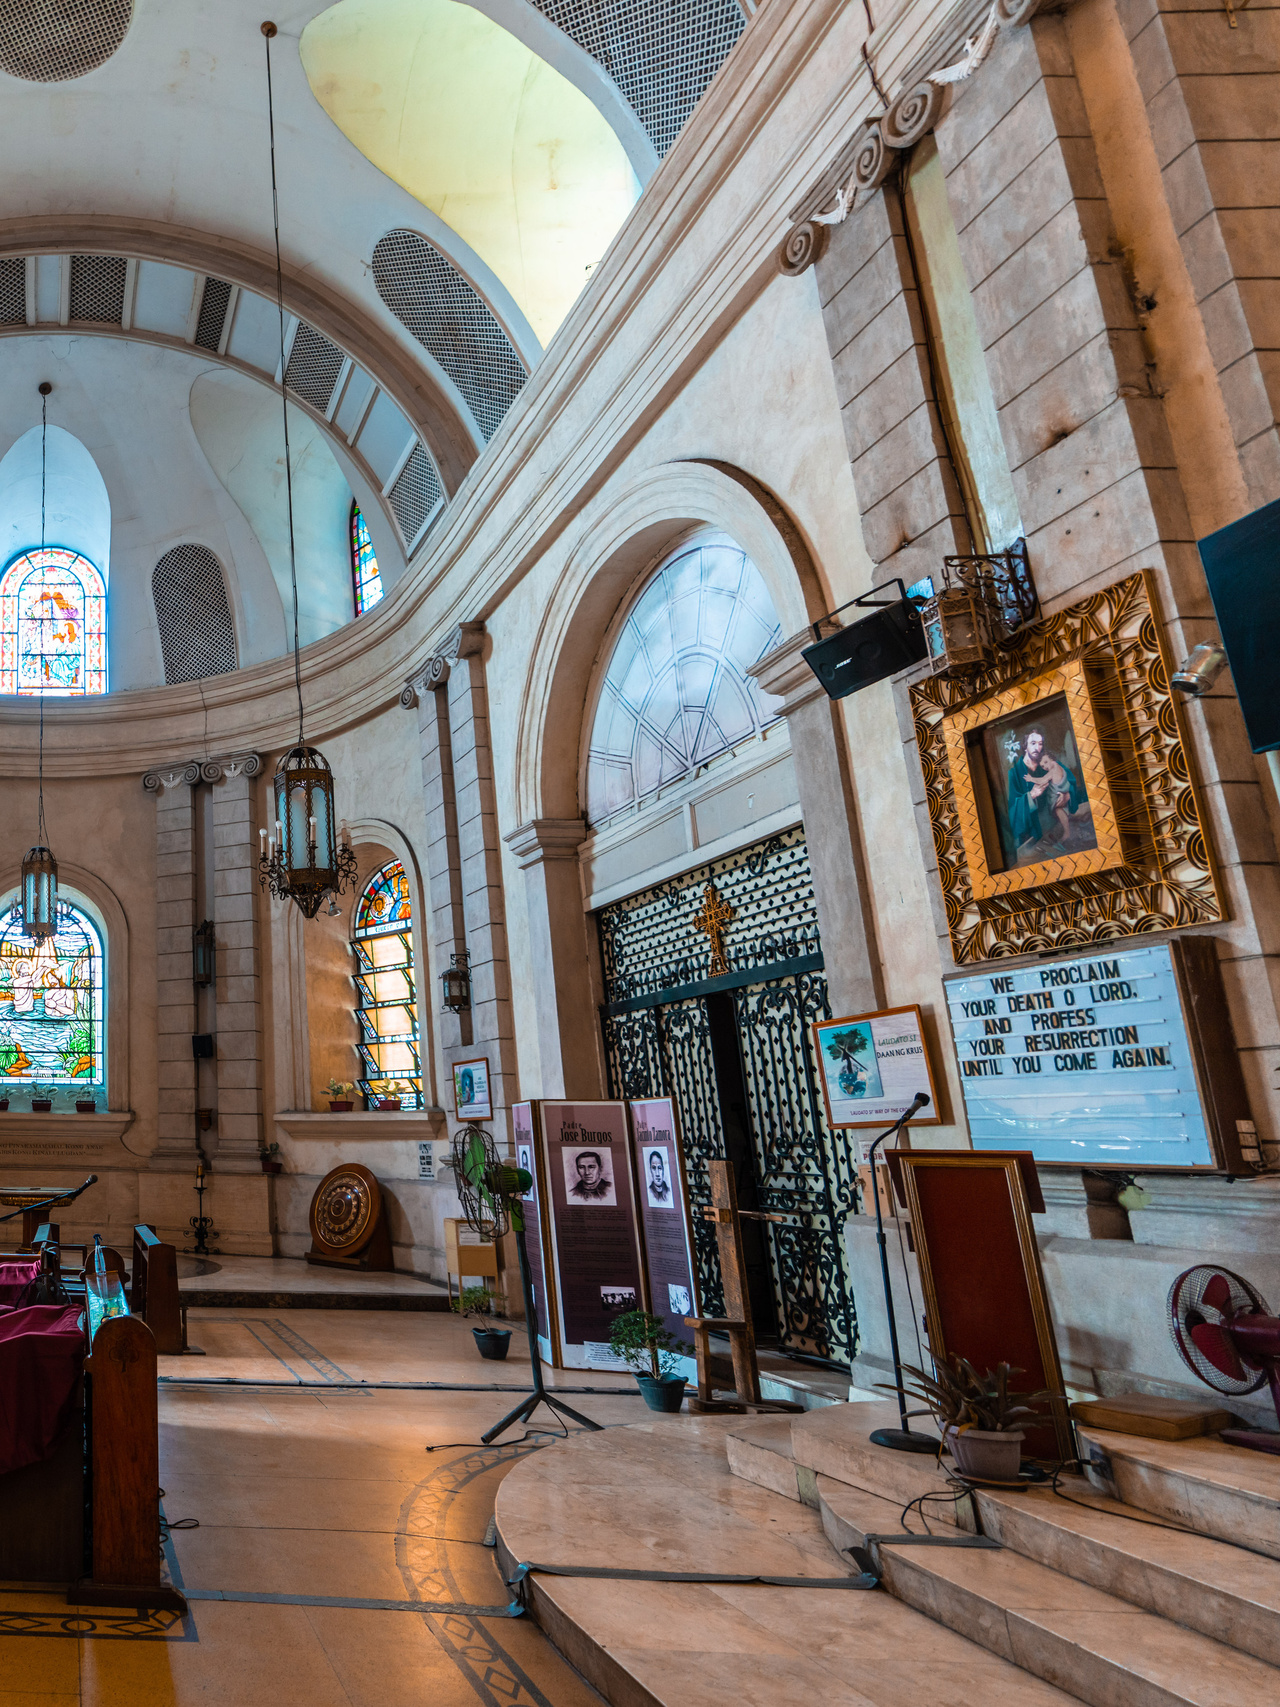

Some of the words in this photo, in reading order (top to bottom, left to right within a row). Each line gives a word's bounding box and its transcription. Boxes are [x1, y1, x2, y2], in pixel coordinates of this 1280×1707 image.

[990, 976, 1015, 994] WE
[1039, 959, 1121, 988] PROCLAIM
[961, 999, 997, 1018] YOUR
[1007, 991, 1055, 1013] DEATH
[1064, 989, 1075, 1006] O
[1089, 981, 1138, 1003] LORD,
[984, 1017, 1012, 1035] AND
[1031, 1008, 1096, 1031] PROFESS
[877, 1050, 895, 1059] DAAN
[895, 1048, 905, 1056] NG
[906, 1046, 923, 1055] KRUS
[878, 1035, 908, 1046] LAUDATO
[969, 1038, 1006, 1056] YOUR
[1024, 1025, 1139, 1053] RESURRECTION
[962, 1059, 1003, 1077] UNTIL
[1012, 1056, 1041, 1074] YOU
[1054, 1052, 1097, 1071] COME
[1112, 1047, 1171, 1069] AGAIN.
[559, 1127, 579, 1142] Jose
[580, 1127, 613, 1144] Burgos
[562, 1120, 582, 1129] Padre
